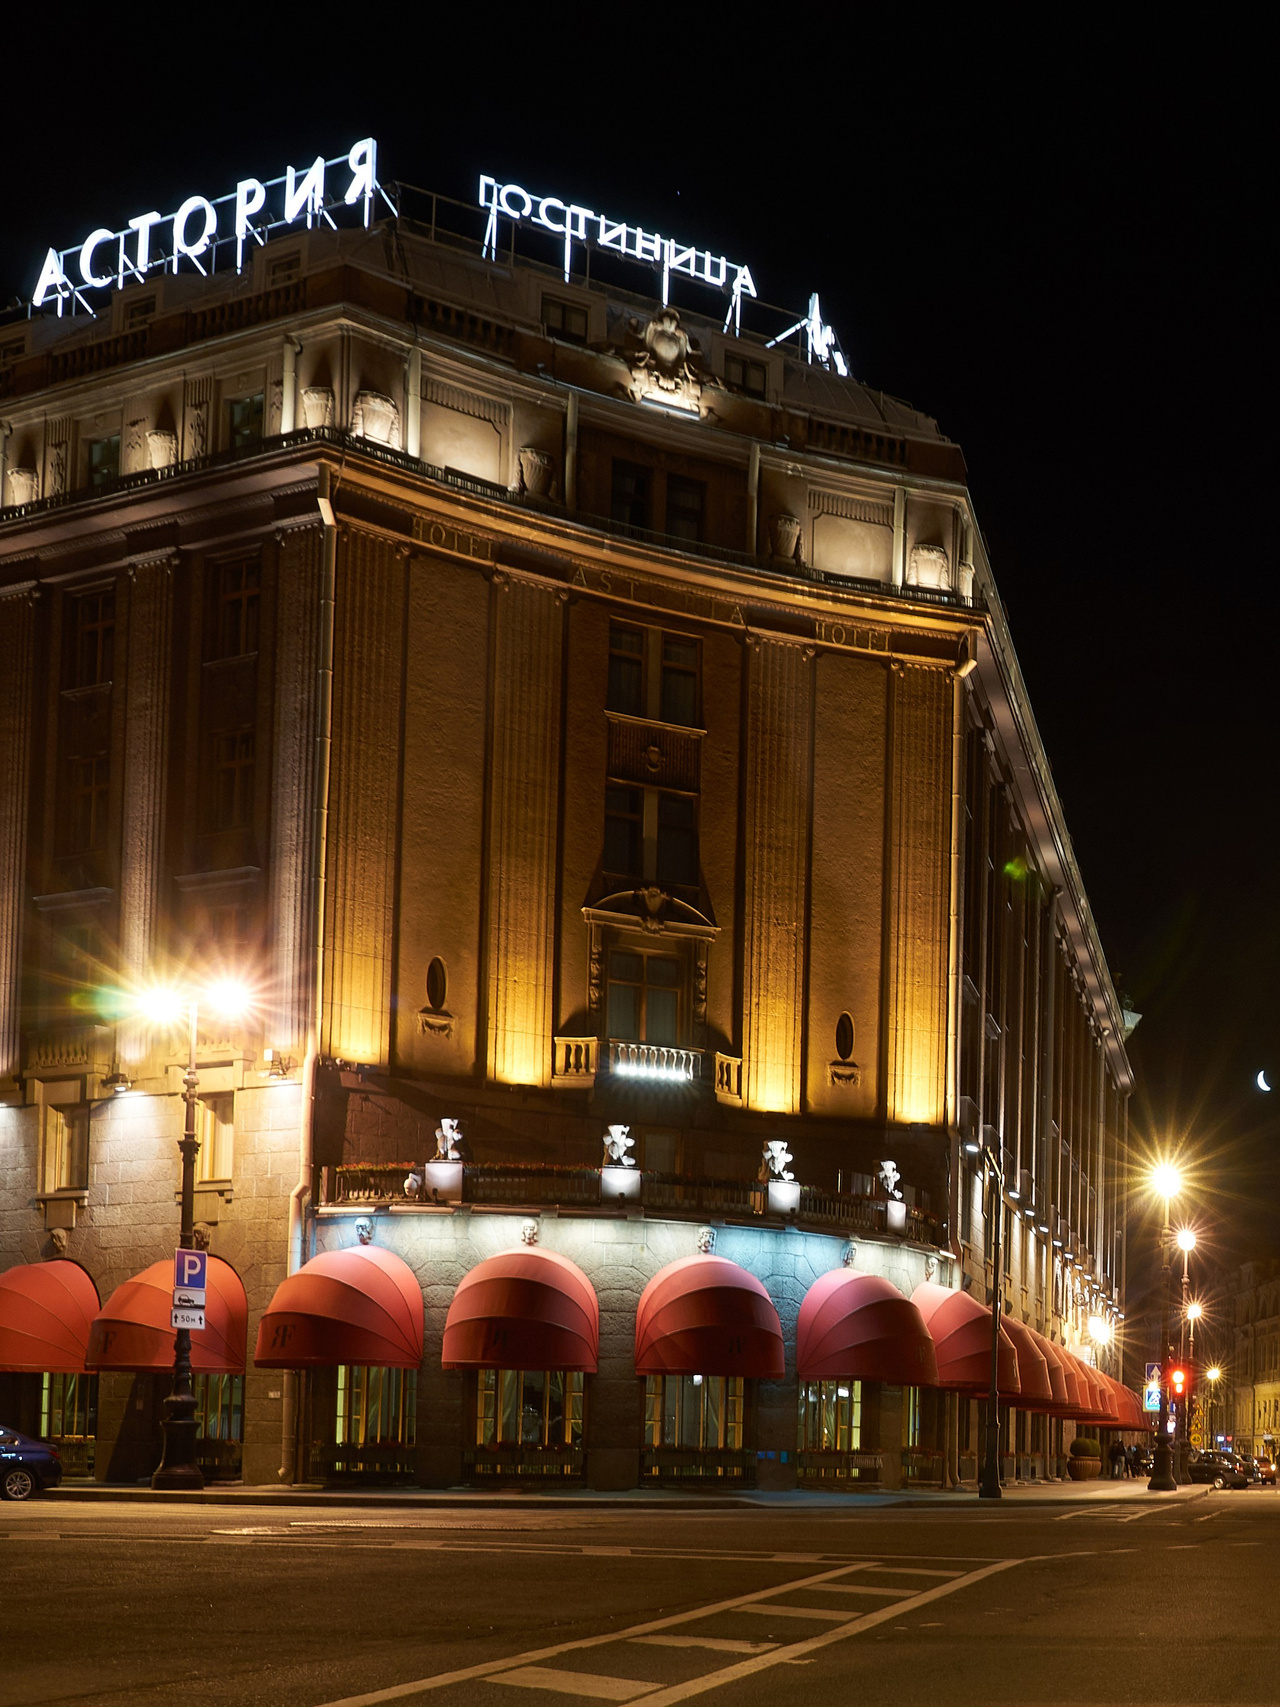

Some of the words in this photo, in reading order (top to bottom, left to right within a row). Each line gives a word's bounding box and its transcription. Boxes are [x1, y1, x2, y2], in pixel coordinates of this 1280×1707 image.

[33, 137, 377, 306] АСТОРИЯ
[479, 174, 757, 298] ГОСТИНИЦА
[571, 565, 746, 626] ASTRIA
[184, 1254, 202, 1285] P
